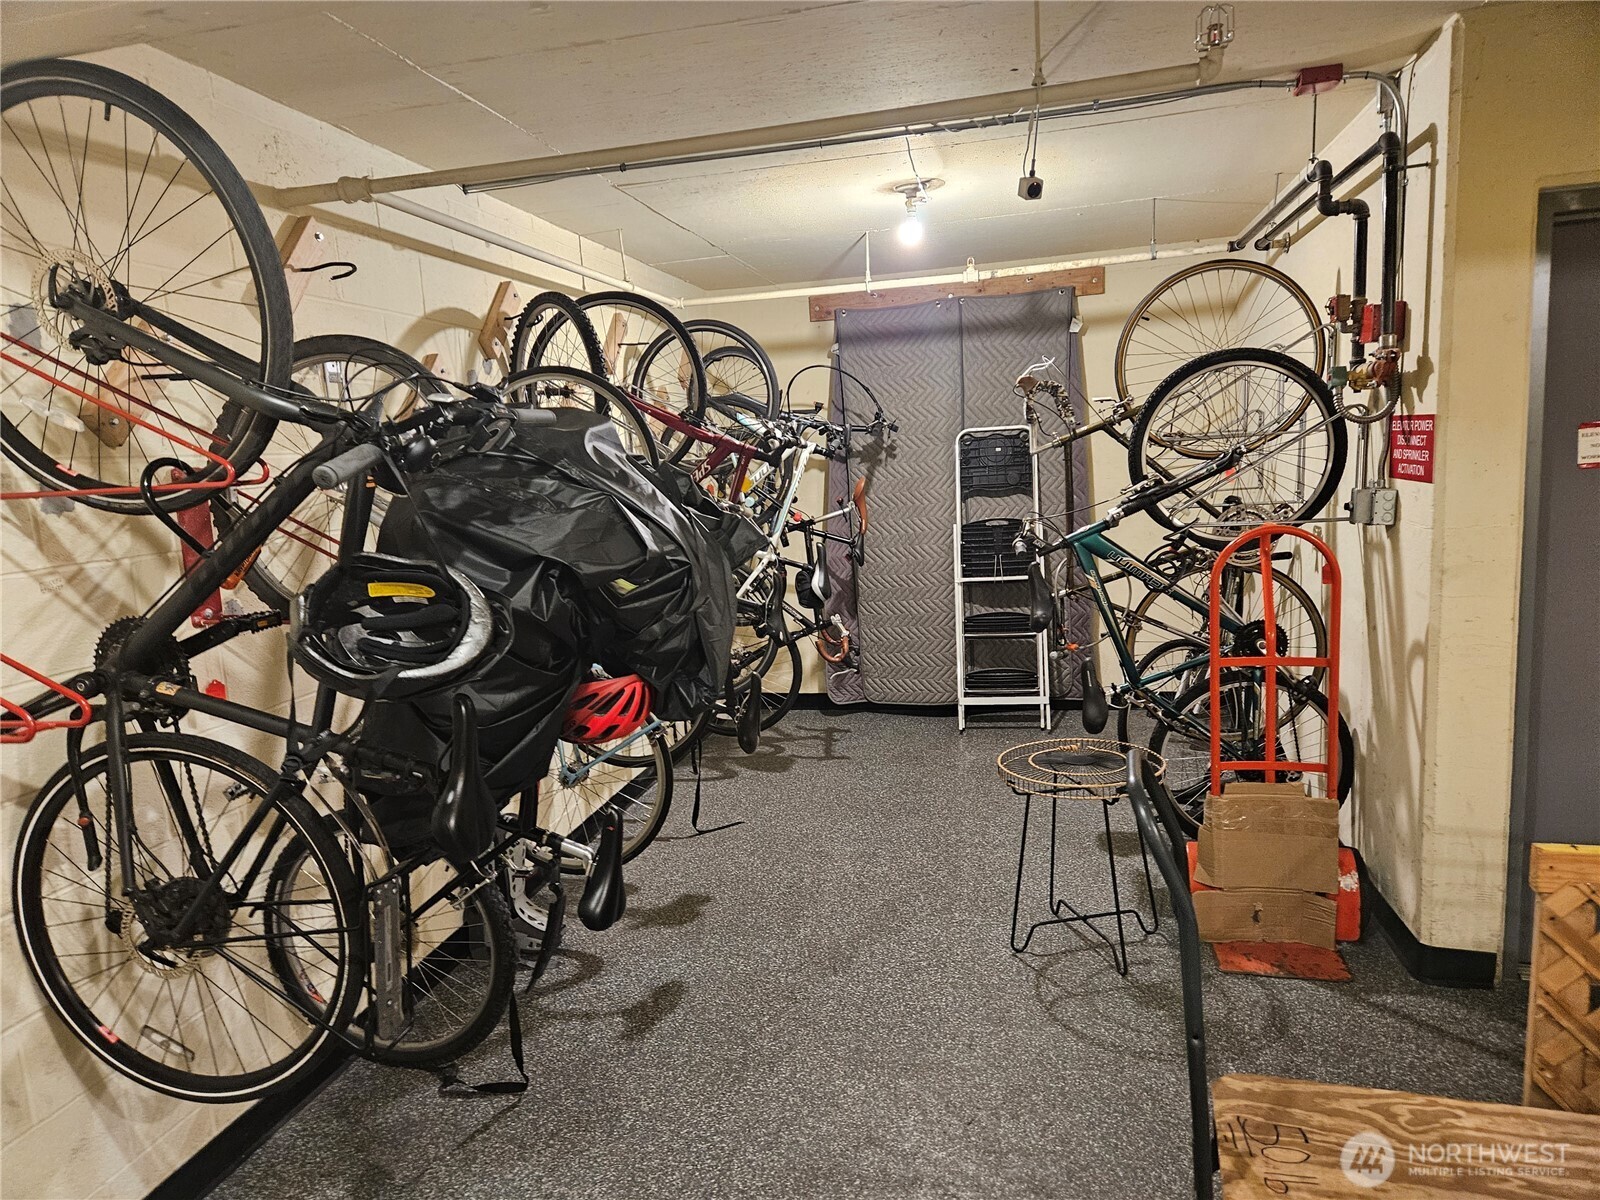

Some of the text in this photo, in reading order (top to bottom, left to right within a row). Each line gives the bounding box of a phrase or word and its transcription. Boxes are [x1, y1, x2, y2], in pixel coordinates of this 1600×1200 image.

[1392, 420, 1433, 431] ELEVATOR POWER
[1397, 434, 1427, 446] DISCONNECT
[1393, 448, 1430, 461] AND SPRINKLER
[1397, 463, 1425, 476] ACTIVATION
